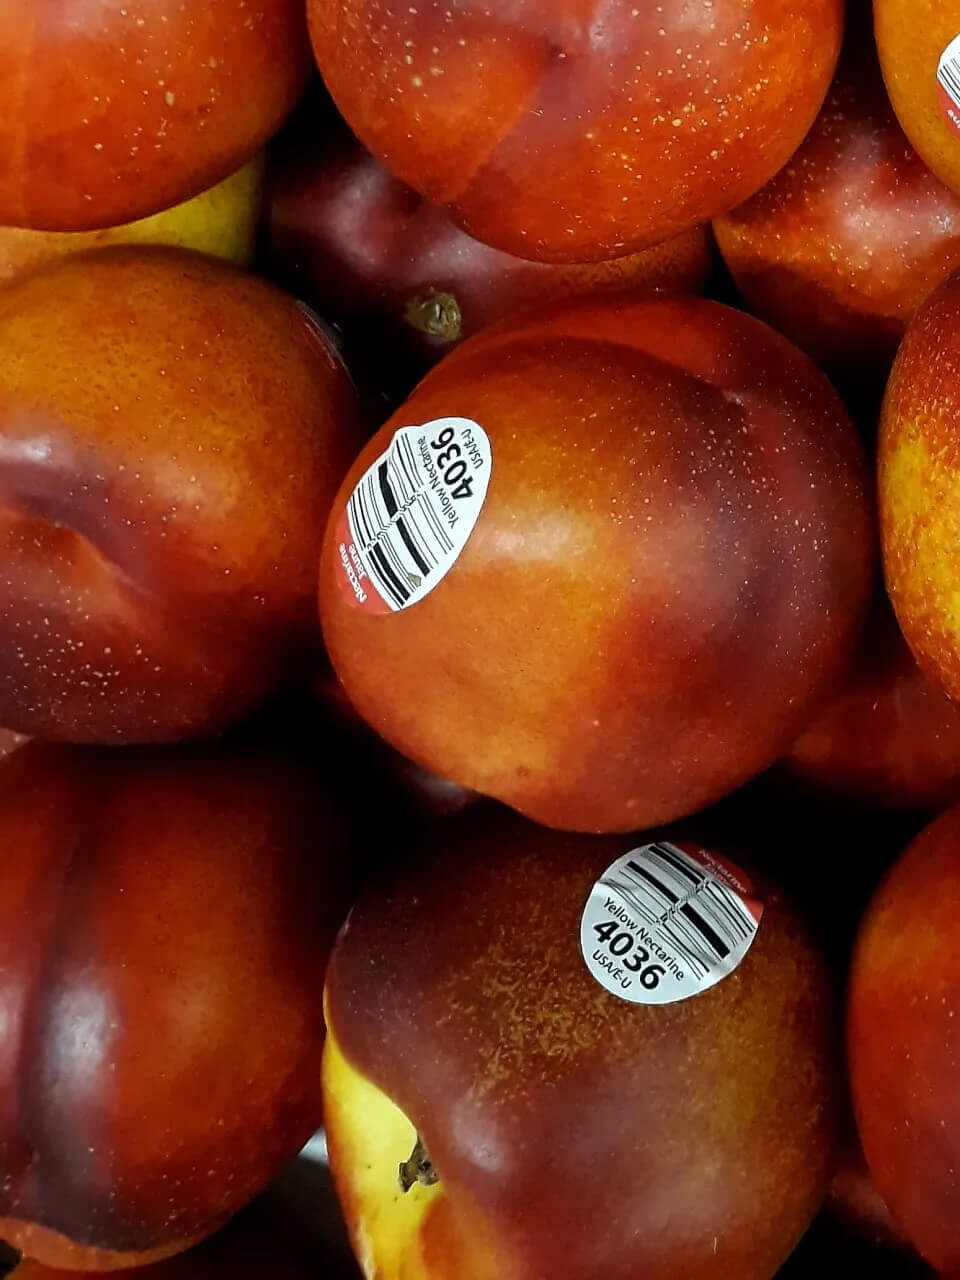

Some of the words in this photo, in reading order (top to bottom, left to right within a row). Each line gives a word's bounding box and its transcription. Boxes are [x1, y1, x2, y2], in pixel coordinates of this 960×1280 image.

[416, 435, 439, 491] Nectarine
[430, 427, 474, 501] 4036
[438, 487, 460, 529] Yellow
[349, 542, 368, 581] Jaune
[592, 919, 667, 990] 4036
[602, 896, 639, 931] Yellow
[635, 926, 685, 982] Nectarine
